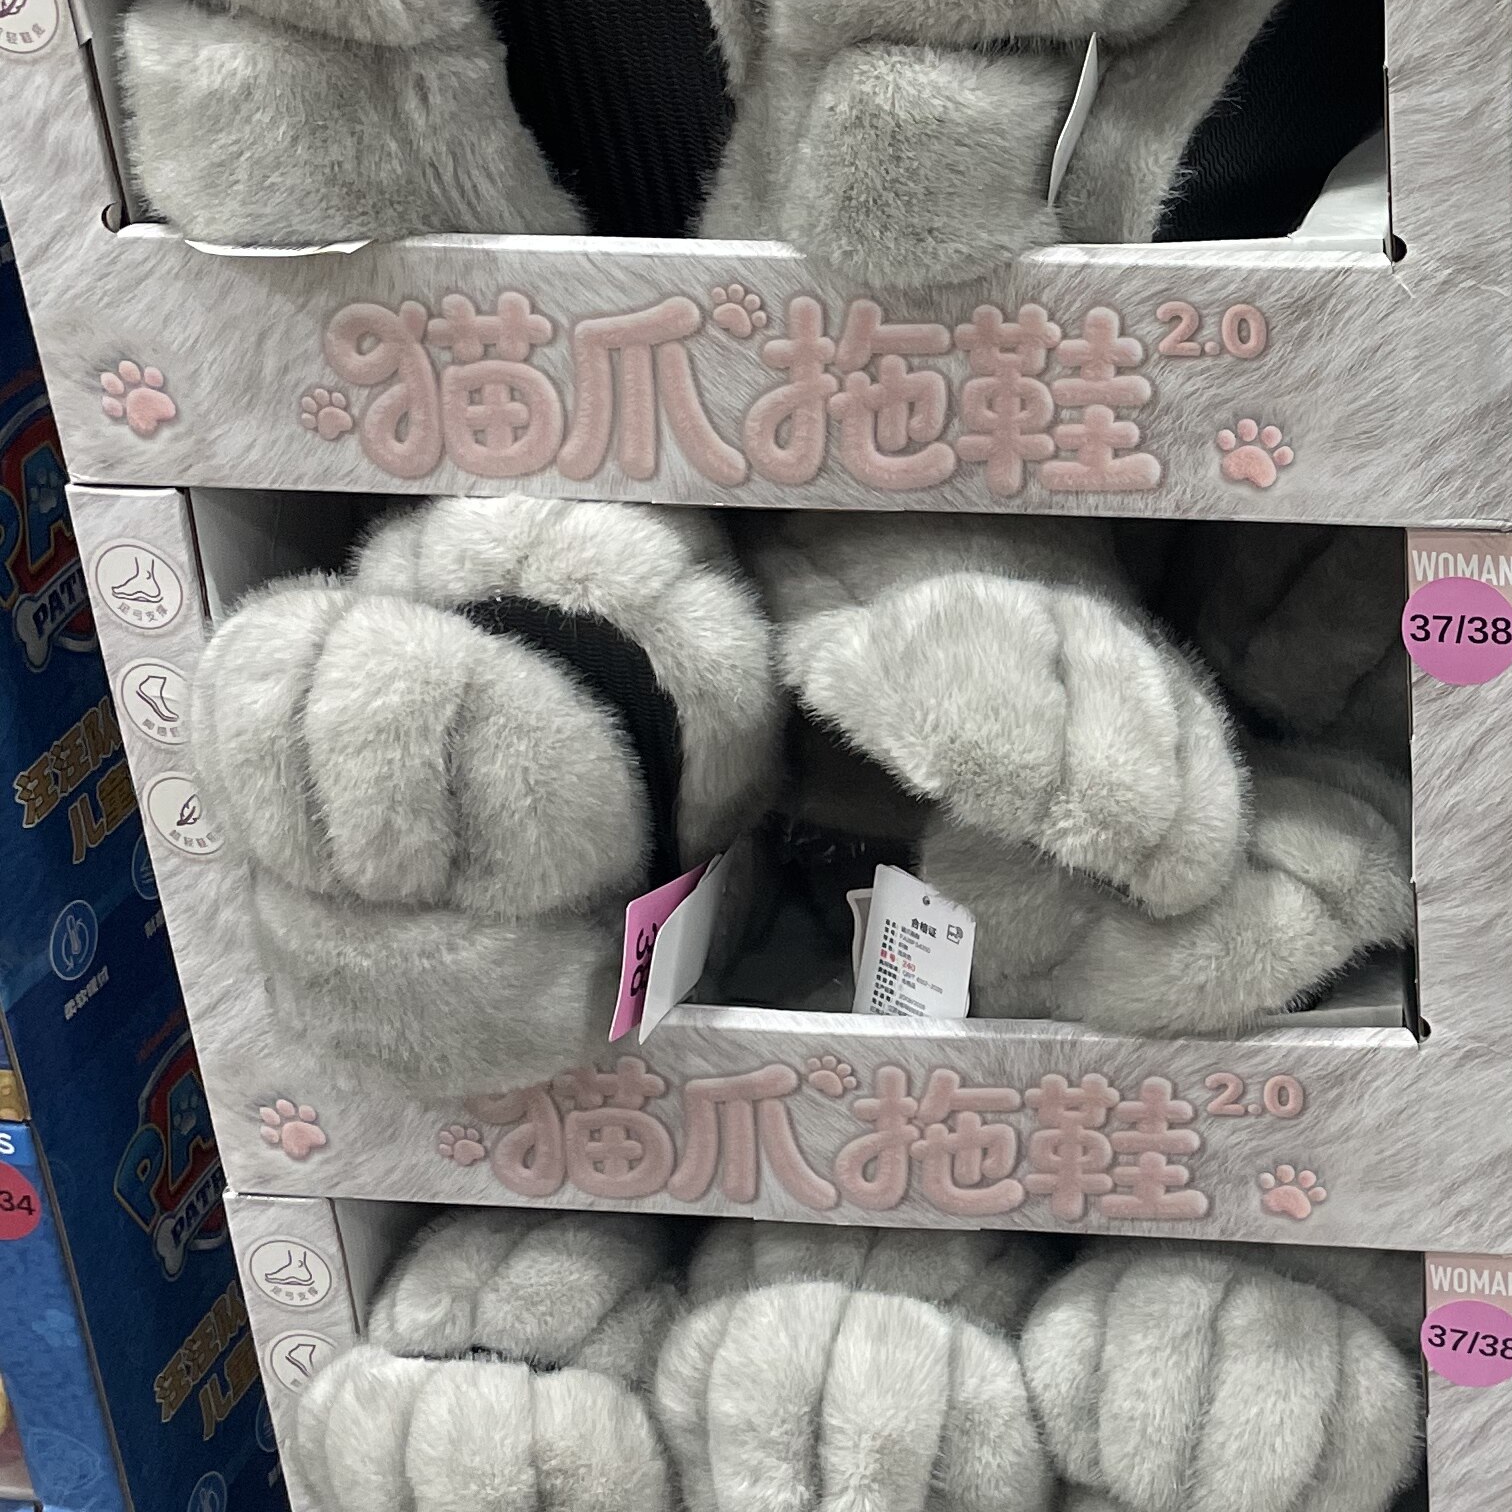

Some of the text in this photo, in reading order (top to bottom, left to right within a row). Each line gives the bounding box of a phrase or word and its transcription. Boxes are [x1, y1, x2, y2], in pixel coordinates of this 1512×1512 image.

[323, 289, 1271, 493] 猫爪拖鞋 2.0
[465, 1055, 1307, 1223] 猫爪拖鞋 2.0
